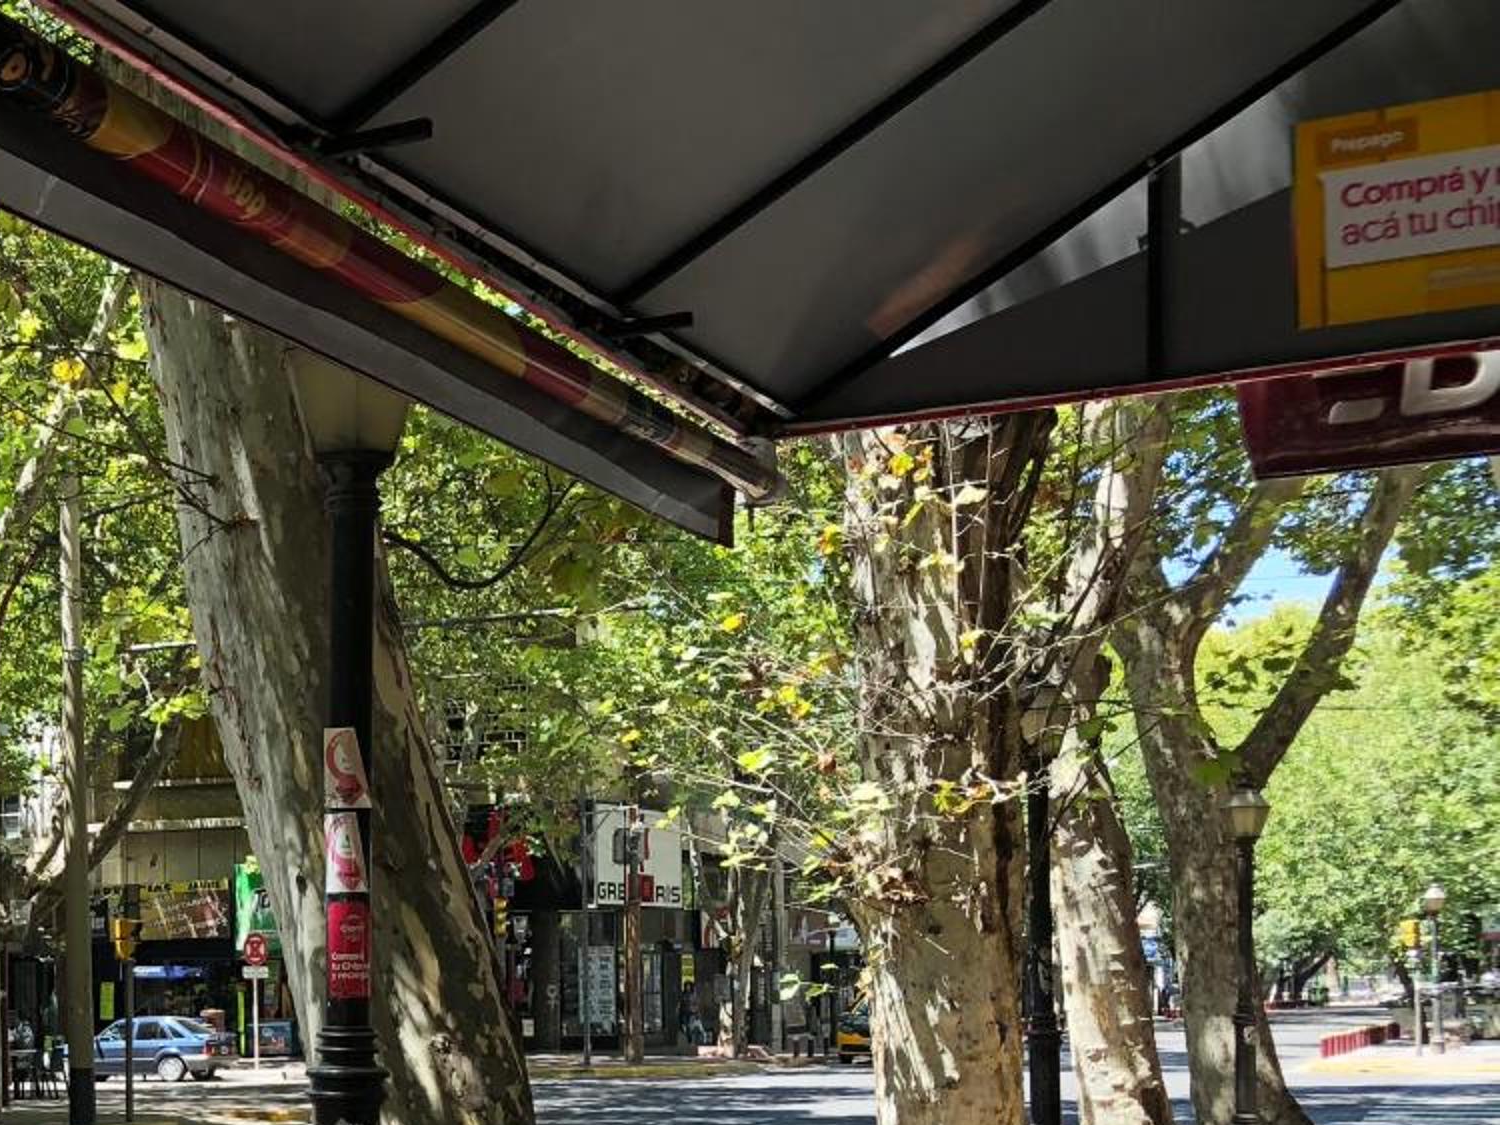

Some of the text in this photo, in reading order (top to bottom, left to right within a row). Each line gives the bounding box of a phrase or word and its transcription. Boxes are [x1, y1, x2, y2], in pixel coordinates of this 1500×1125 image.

[1341, 166, 1466, 207] Comprá
[1470, 167, 1490, 195] y
[1341, 211, 1400, 245] acá
[1408, 212, 1438, 236] tu
